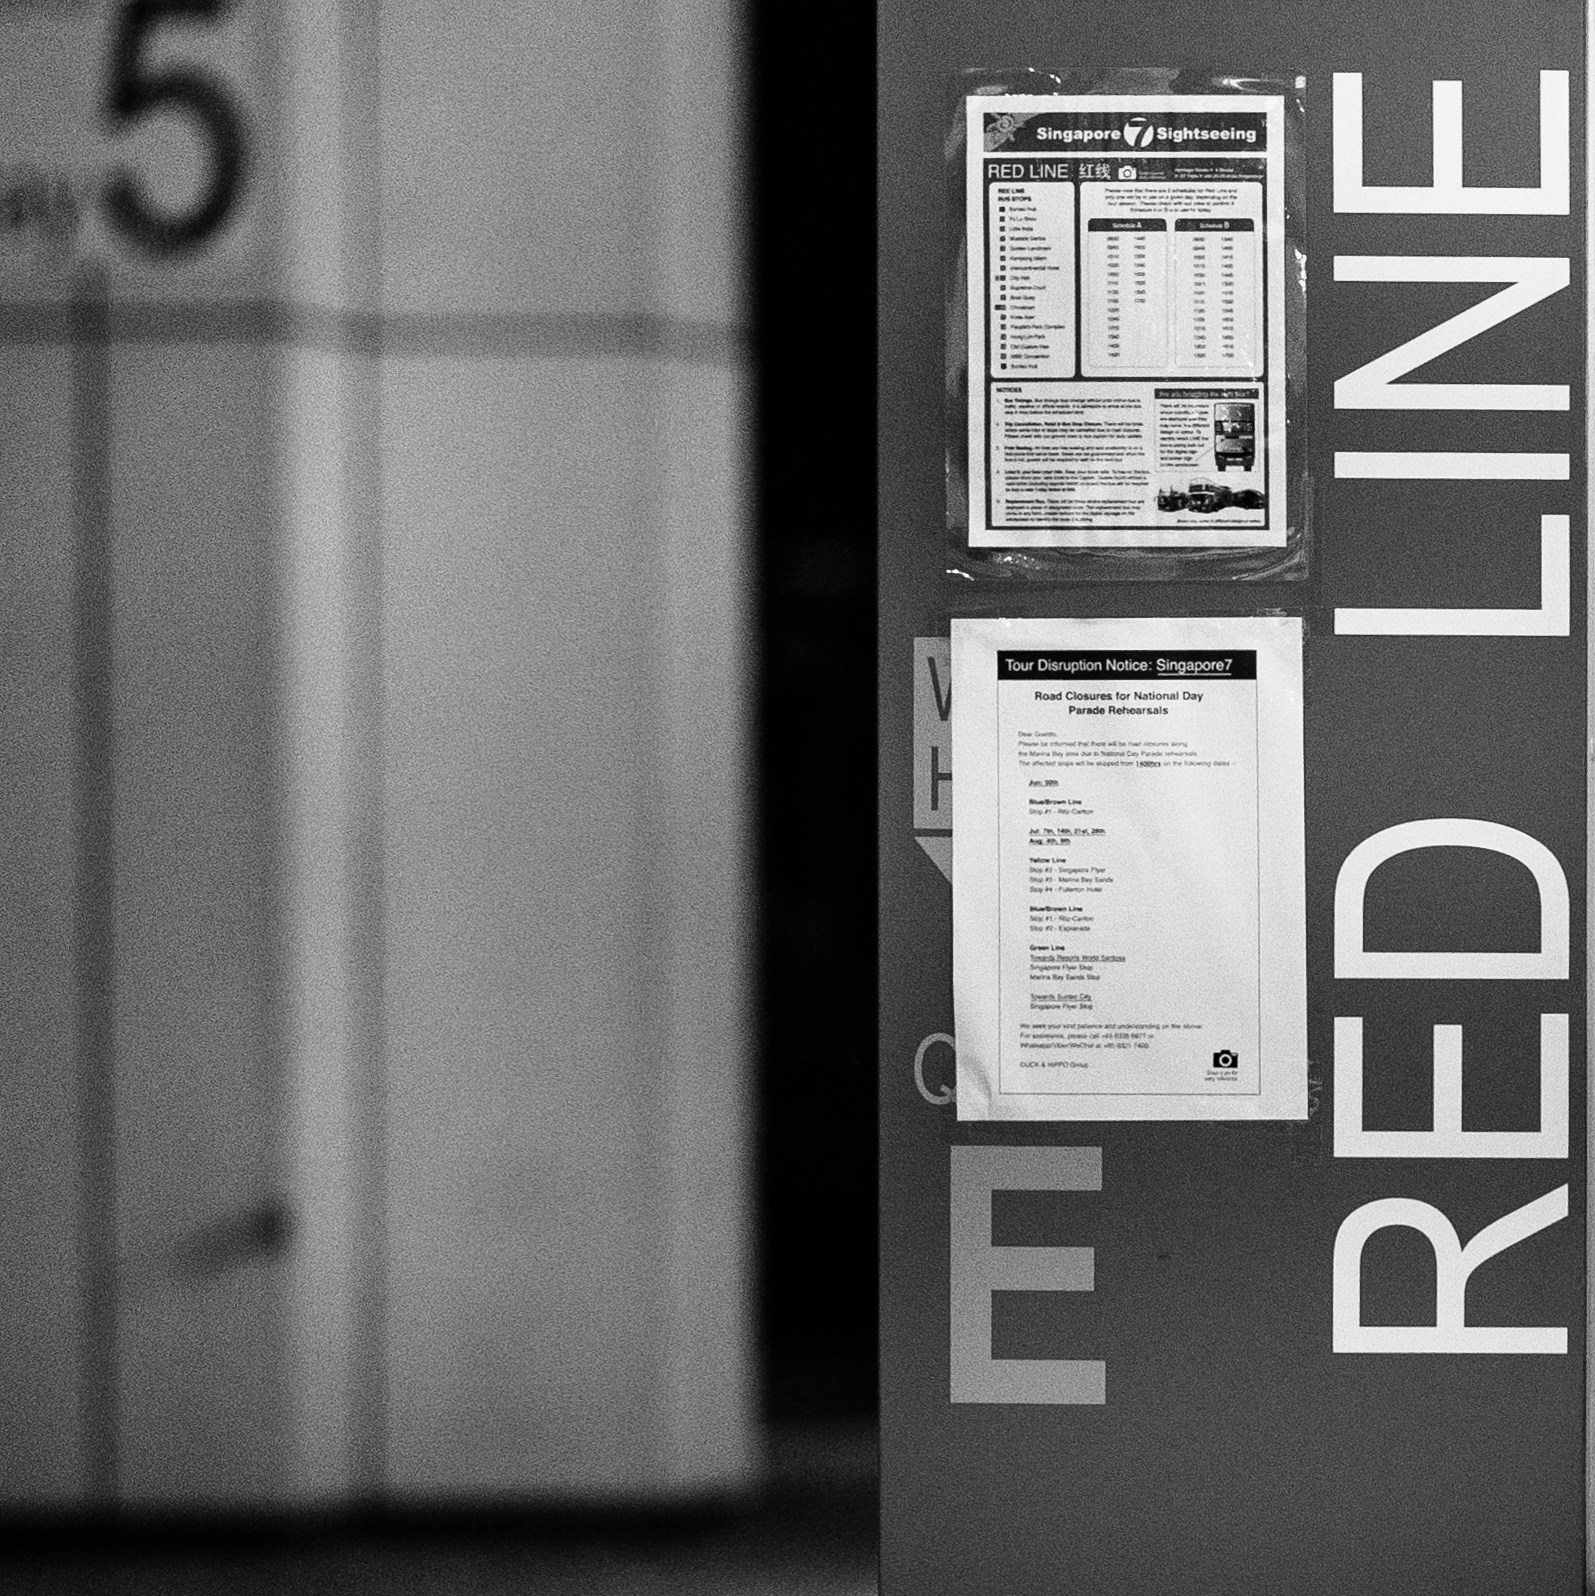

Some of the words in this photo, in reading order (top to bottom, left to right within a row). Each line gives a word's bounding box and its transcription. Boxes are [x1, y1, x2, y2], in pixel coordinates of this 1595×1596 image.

[104, 0, 248, 256] 5
[1036, 126, 1122, 143] Singapore
[1156, 126, 1257, 143] Sightseeing
[988, 164, 1025, 179] RED
[1029, 164, 1069, 179] LINE
[1078, 163, 1112, 180] 红线
[1333, 70, 1570, 637] LINE
[1005, 658, 1034, 672] Tour
[1038, 658, 1102, 674] Disruption
[1106, 658, 1152, 672] Notice:
[1156, 658, 1233, 674] Singapore7
[1034, 691, 1062, 701] Road
[1065, 691, 1113, 701] Closures
[1116, 691, 1131, 701] for
[1134, 691, 1179, 701] National
[1183, 691, 1204, 703] Day
[1068, 705, 1106, 715] Parade
[1108, 705, 1169, 715] Rehearsals
[1333, 816, 1570, 1354] RED
[950, 1146, 1106, 1405] E
